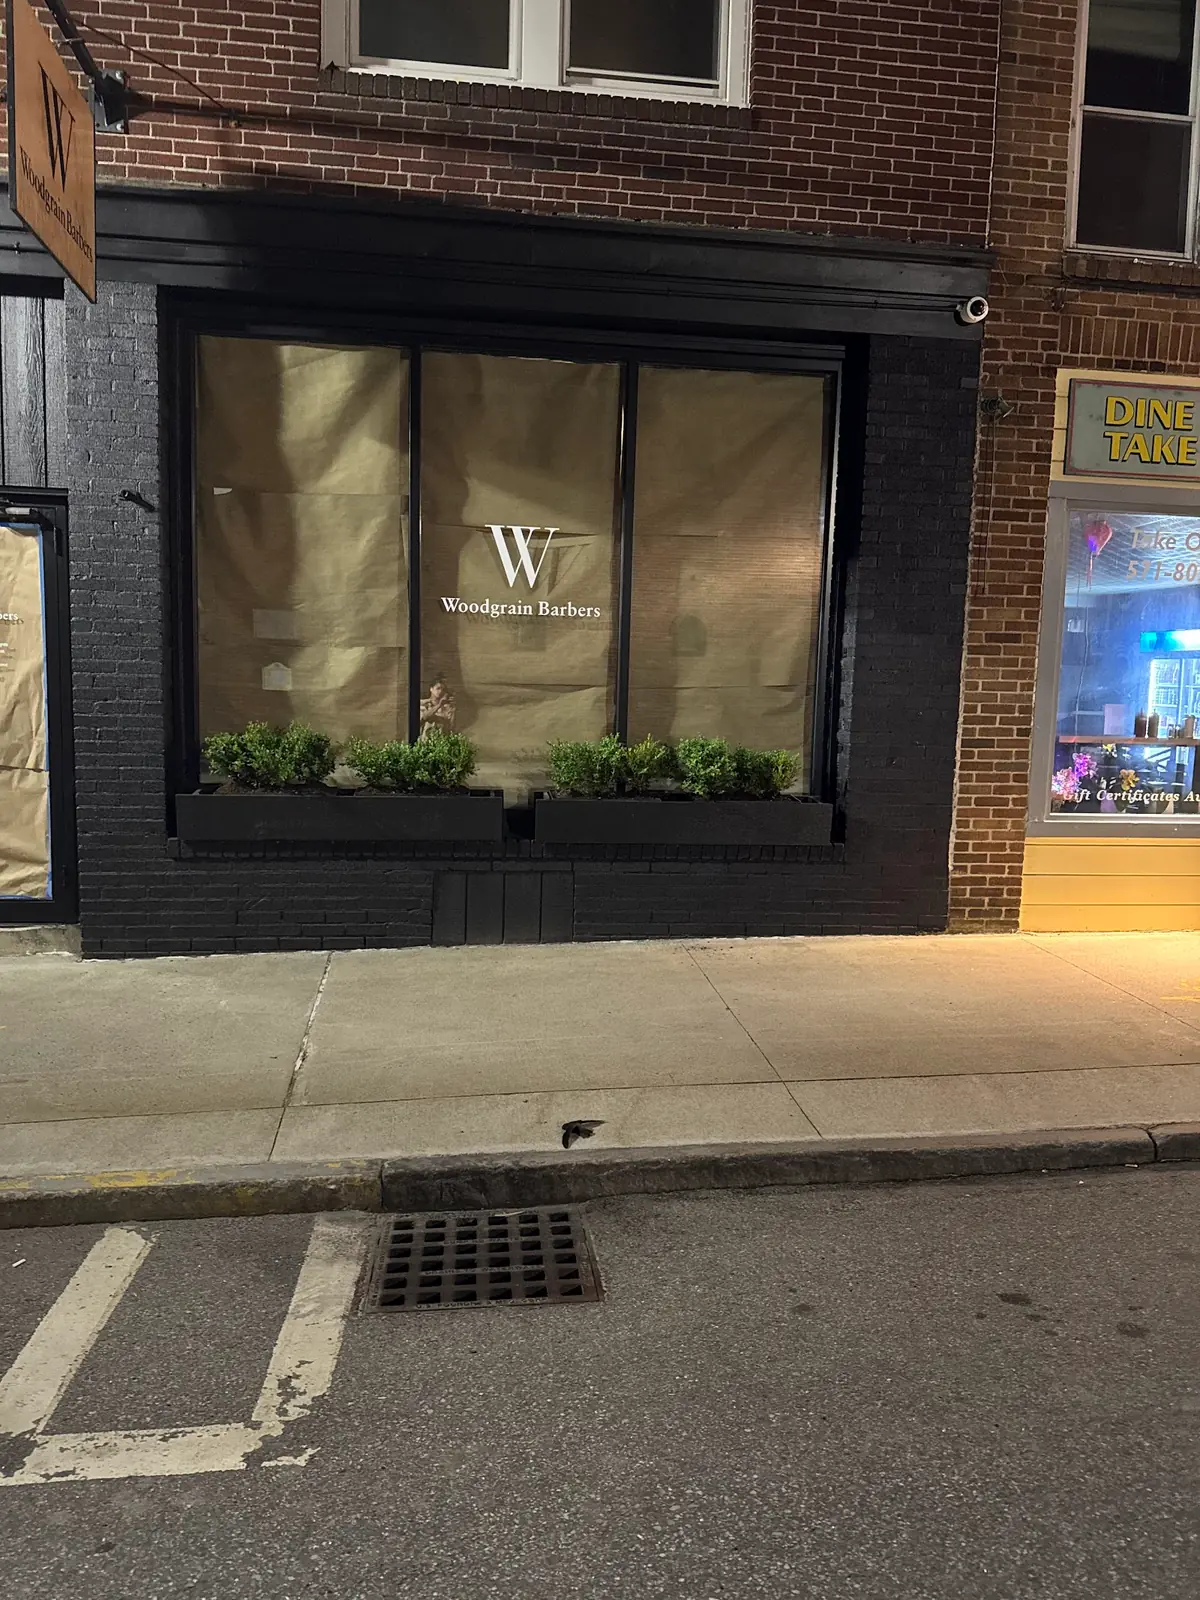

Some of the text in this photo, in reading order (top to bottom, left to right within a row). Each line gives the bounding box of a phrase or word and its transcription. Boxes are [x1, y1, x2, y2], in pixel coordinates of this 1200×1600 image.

[38, 60, 75, 193] W
[20, 144, 93, 263] Woodgrain Barbers
[1104, 396, 1195, 431] DINE
[1103, 430, 1198, 466] TAKE
[485, 524, 560, 589] W
[1127, 560, 1200, 582] 571-80
[441, 597, 601, 618] Woodgrain Barbers
[1096, 789, 1180, 804] Certificates
